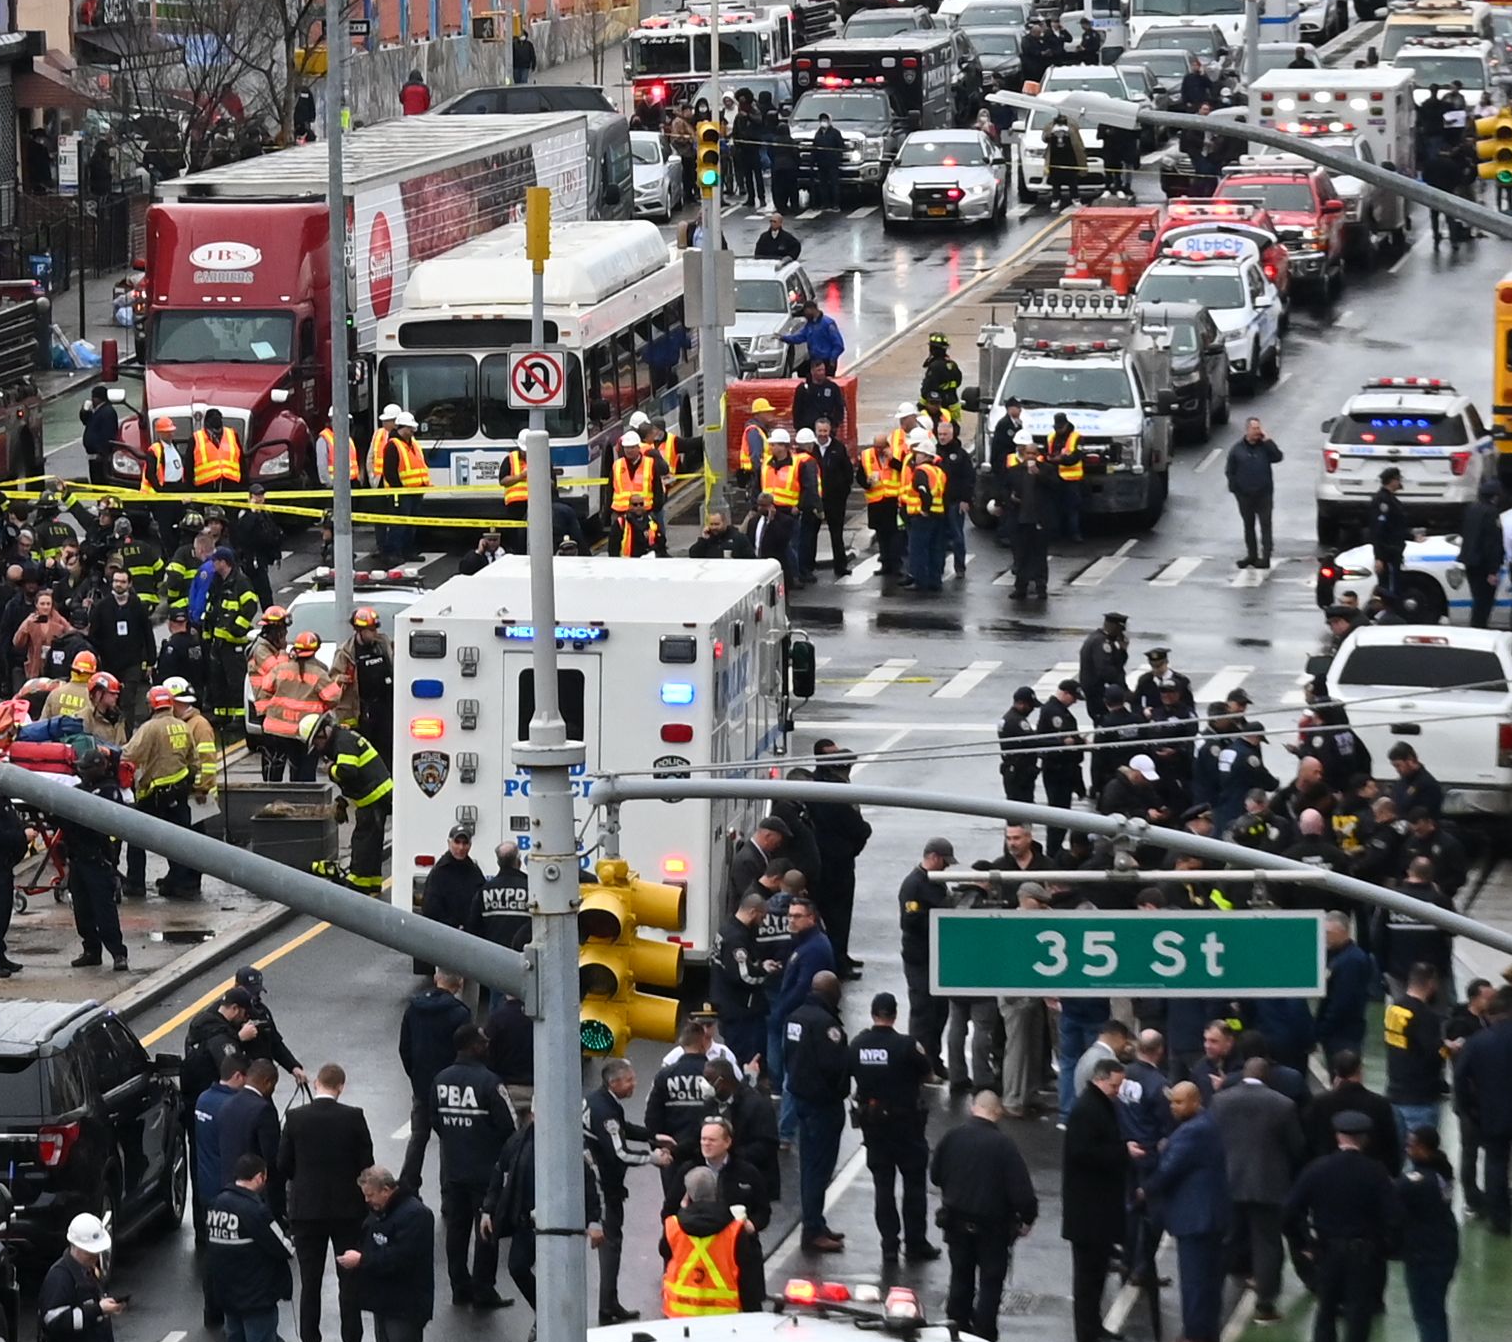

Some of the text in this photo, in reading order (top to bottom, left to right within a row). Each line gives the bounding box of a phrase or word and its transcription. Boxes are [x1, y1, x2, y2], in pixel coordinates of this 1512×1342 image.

[201, 249, 247, 262] JBS
[193, 271, 254, 284] CARRIERS
[481, 888, 526, 903] NYPD
[483, 901, 526, 912] POLICE
[1035, 928, 1226, 977] 35 St
[858, 1048, 888, 1062] NYPD
[436, 1084, 479, 1108] PBA
[442, 1115, 474, 1128] NYPD
[205, 1210, 239, 1231] NYPD
